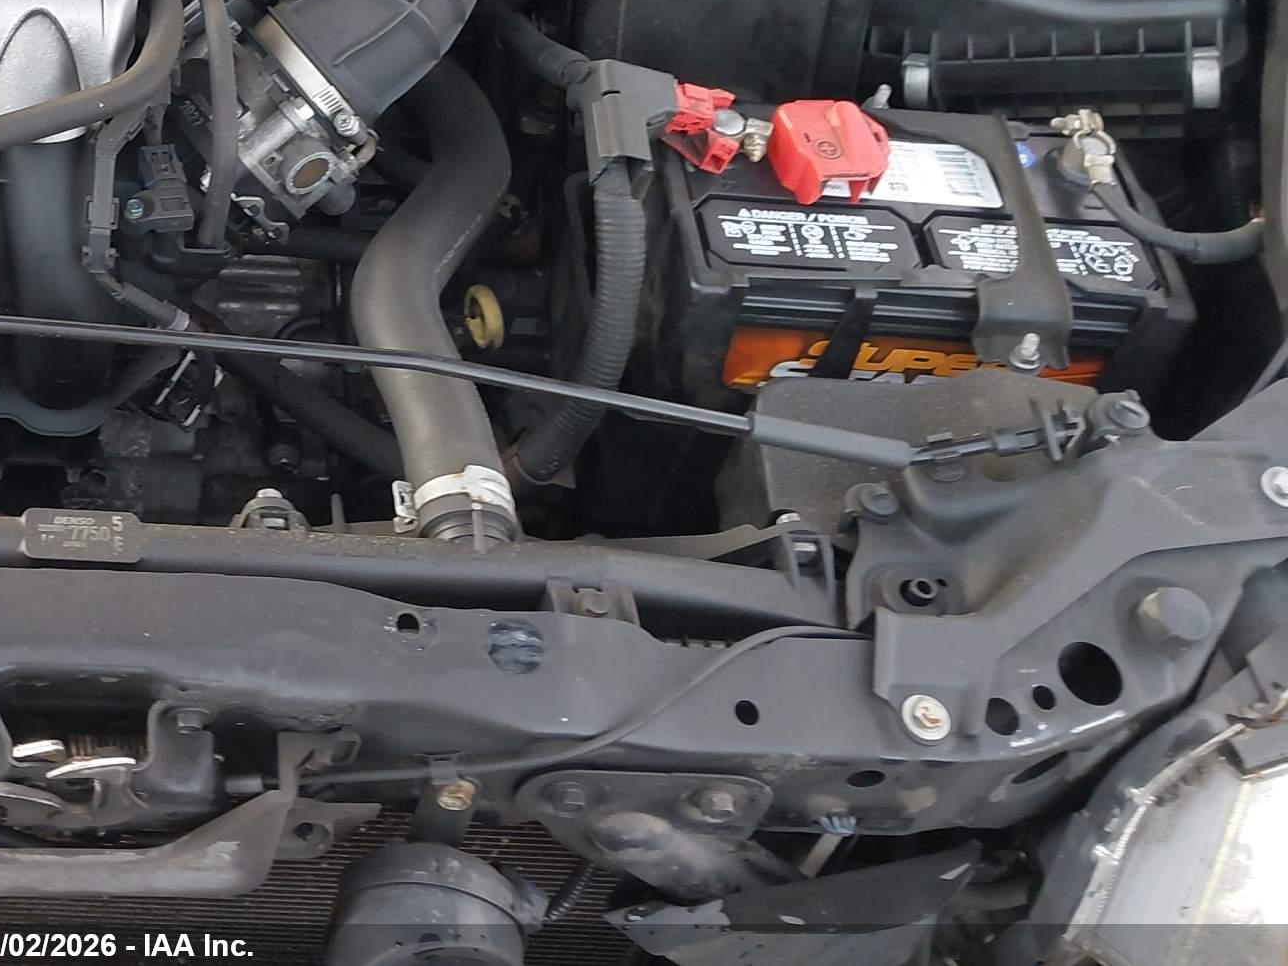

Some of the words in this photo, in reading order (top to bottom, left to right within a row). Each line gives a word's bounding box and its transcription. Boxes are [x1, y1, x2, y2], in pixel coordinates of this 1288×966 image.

[750, 209, 807, 222] DANGER
[817, 213, 869, 225] POISON
[53, 516, 95, 525] DENSO
